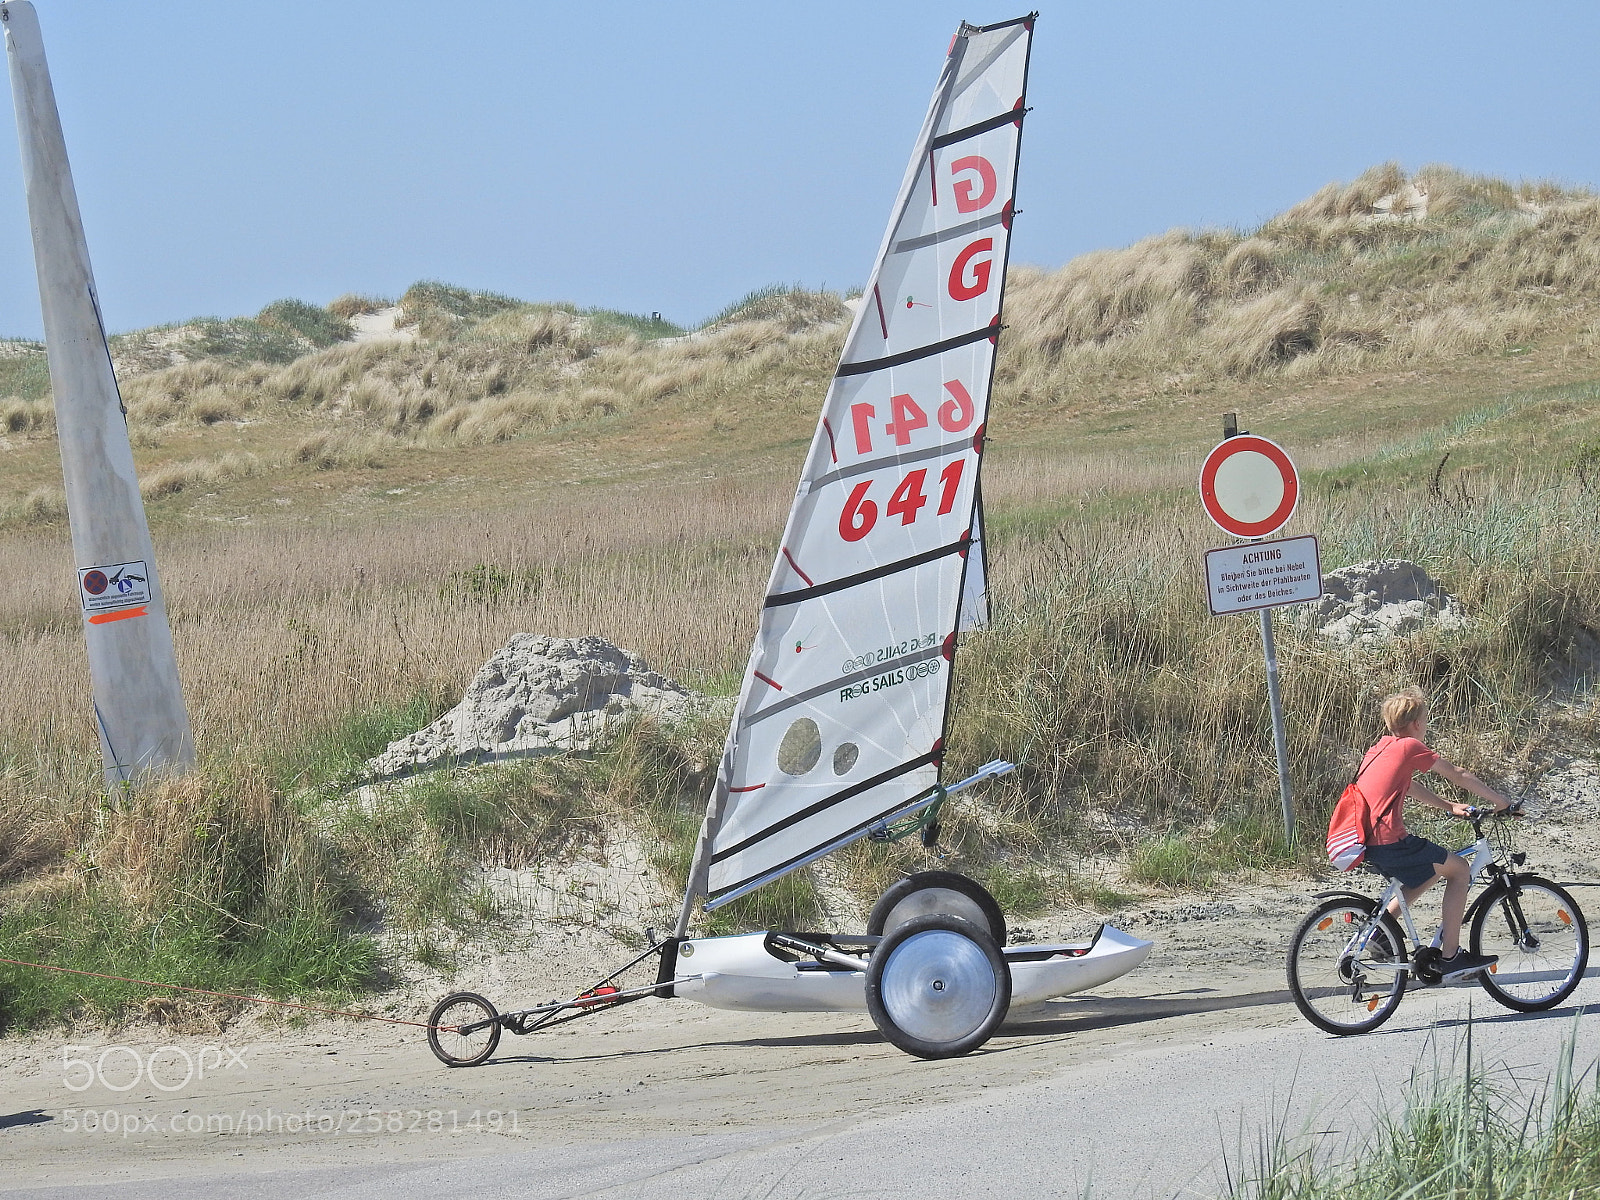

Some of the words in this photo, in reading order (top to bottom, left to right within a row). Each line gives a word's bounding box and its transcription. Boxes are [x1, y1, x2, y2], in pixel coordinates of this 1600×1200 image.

[948, 238, 993, 302] G
[838, 458, 966, 542] 641
[1242, 548, 1282, 565] ACHTUNG
[1220, 570, 1245, 582] Bleiben
[1246, 567, 1257, 578] Sie
[1258, 566, 1274, 576] bitte
[1275, 564, 1286, 573] bei
[1287, 561, 1306, 572] Nebel
[1217, 585, 1225, 594] in
[1225, 579, 1260, 593] Sichtweite
[1260, 577, 1272, 587] der
[1273, 573, 1311, 586] Pfahlbauten
[1237, 593, 1252, 603] oder
[1254, 591, 1266, 600] des
[840, 682, 870, 703] FROG
[872, 670, 904, 691] SAILS
